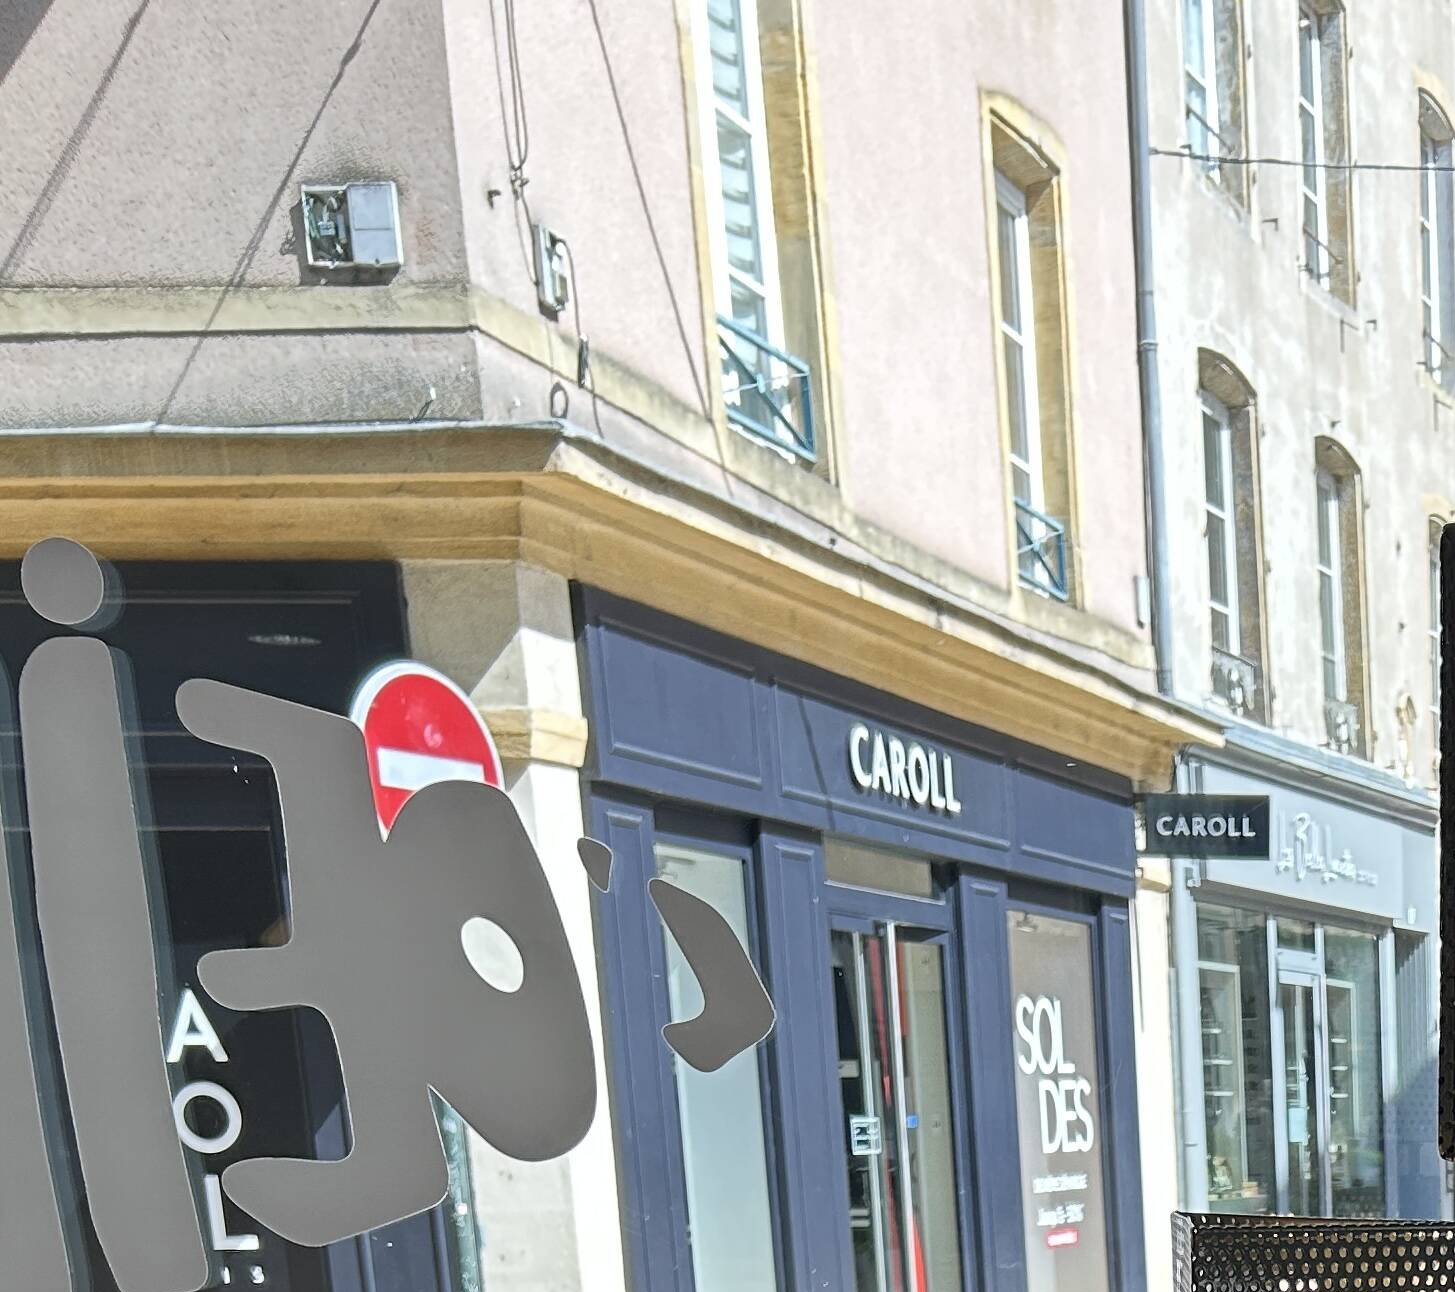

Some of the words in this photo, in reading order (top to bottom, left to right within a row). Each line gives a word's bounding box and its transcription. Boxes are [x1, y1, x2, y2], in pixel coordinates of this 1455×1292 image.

[850, 723, 962, 814] CAROLL
[1156, 814, 1257, 838] CAROLL
[1015, 995, 1076, 1075] SOL
[1038, 1078, 1095, 1153] DES
